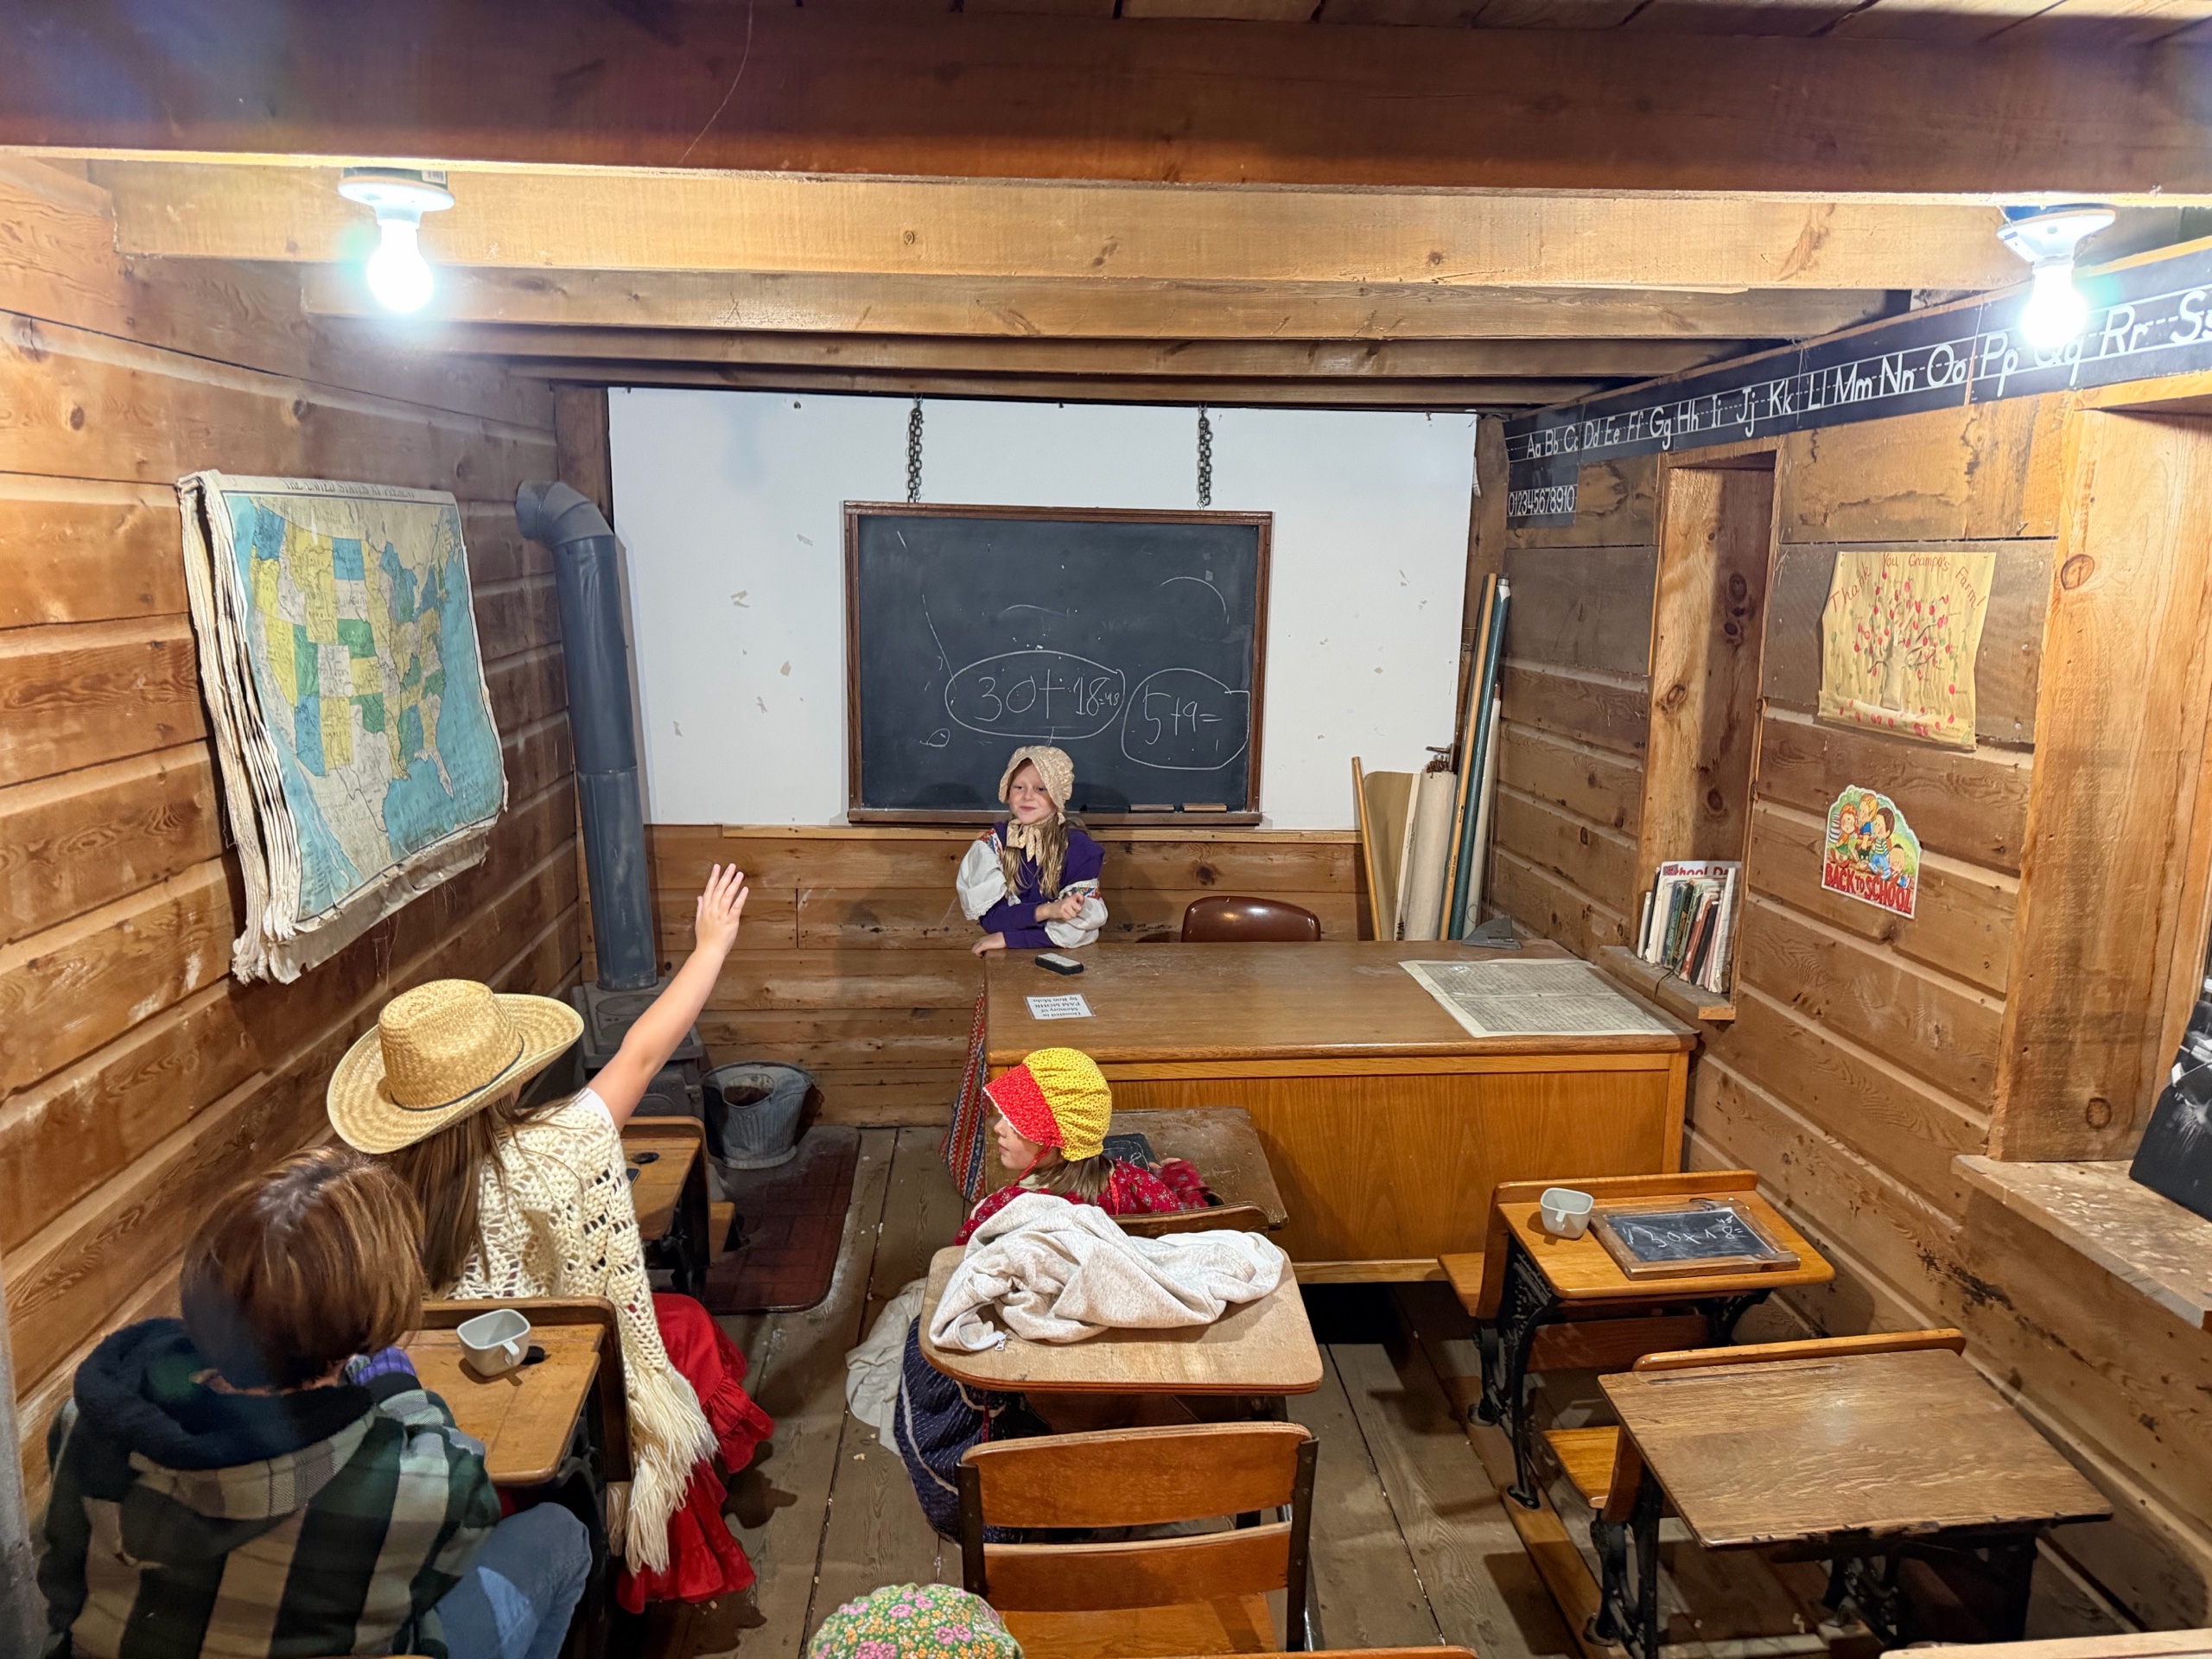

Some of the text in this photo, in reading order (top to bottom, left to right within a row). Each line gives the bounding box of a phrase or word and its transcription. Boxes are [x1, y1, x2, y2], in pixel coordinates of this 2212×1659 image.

[1527, 434, 1541, 459] Aa
[1545, 429, 1559, 456] Bb
[1563, 425, 1579, 452] Cc
[1584, 418, 1600, 449] Dd
[1605, 416, 1620, 445] Ee
[1627, 410, 1643, 442] Ff
[1649, 406, 1671, 449] Gg
[1678, 400, 1699, 434] Hh
[1711, 394, 1721, 428] Ii
[1736, 387, 1756, 437] Jj
[1770, 379, 1792, 417] Kk
[1808, 370, 1827, 410] Ll
[1834, 362, 1872, 405] Mm
[1879, 353, 1915, 397] Nn
[1927, 344, 1967, 387] Oo
[1980, 332, 2018, 397] Pp
[2100, 305, 2149, 358] Rr
[1828, 562, 1872, 613] Thank
[1883, 553, 1898, 571] You
[1955, 566, 1986, 611] Farm!
[1824, 862, 1857, 894] BACK
[1864, 874, 1912, 914] SCHOOL
